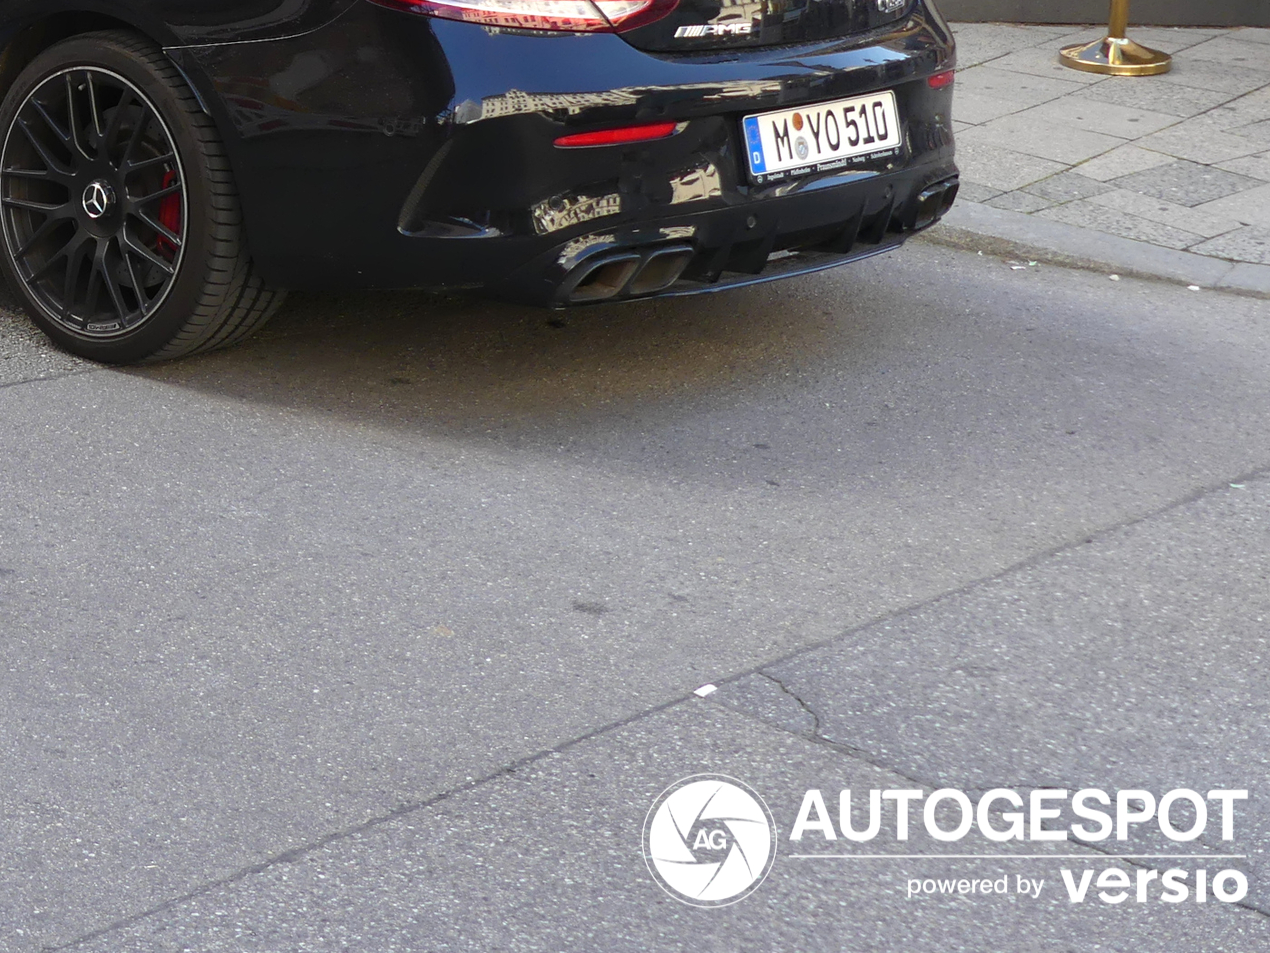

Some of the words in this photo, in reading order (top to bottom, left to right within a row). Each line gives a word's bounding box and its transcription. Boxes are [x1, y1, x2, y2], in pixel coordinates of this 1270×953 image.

[772, 118, 793, 162] M
[806, 109, 841, 154] YO
[843, 101, 889, 147] 510
